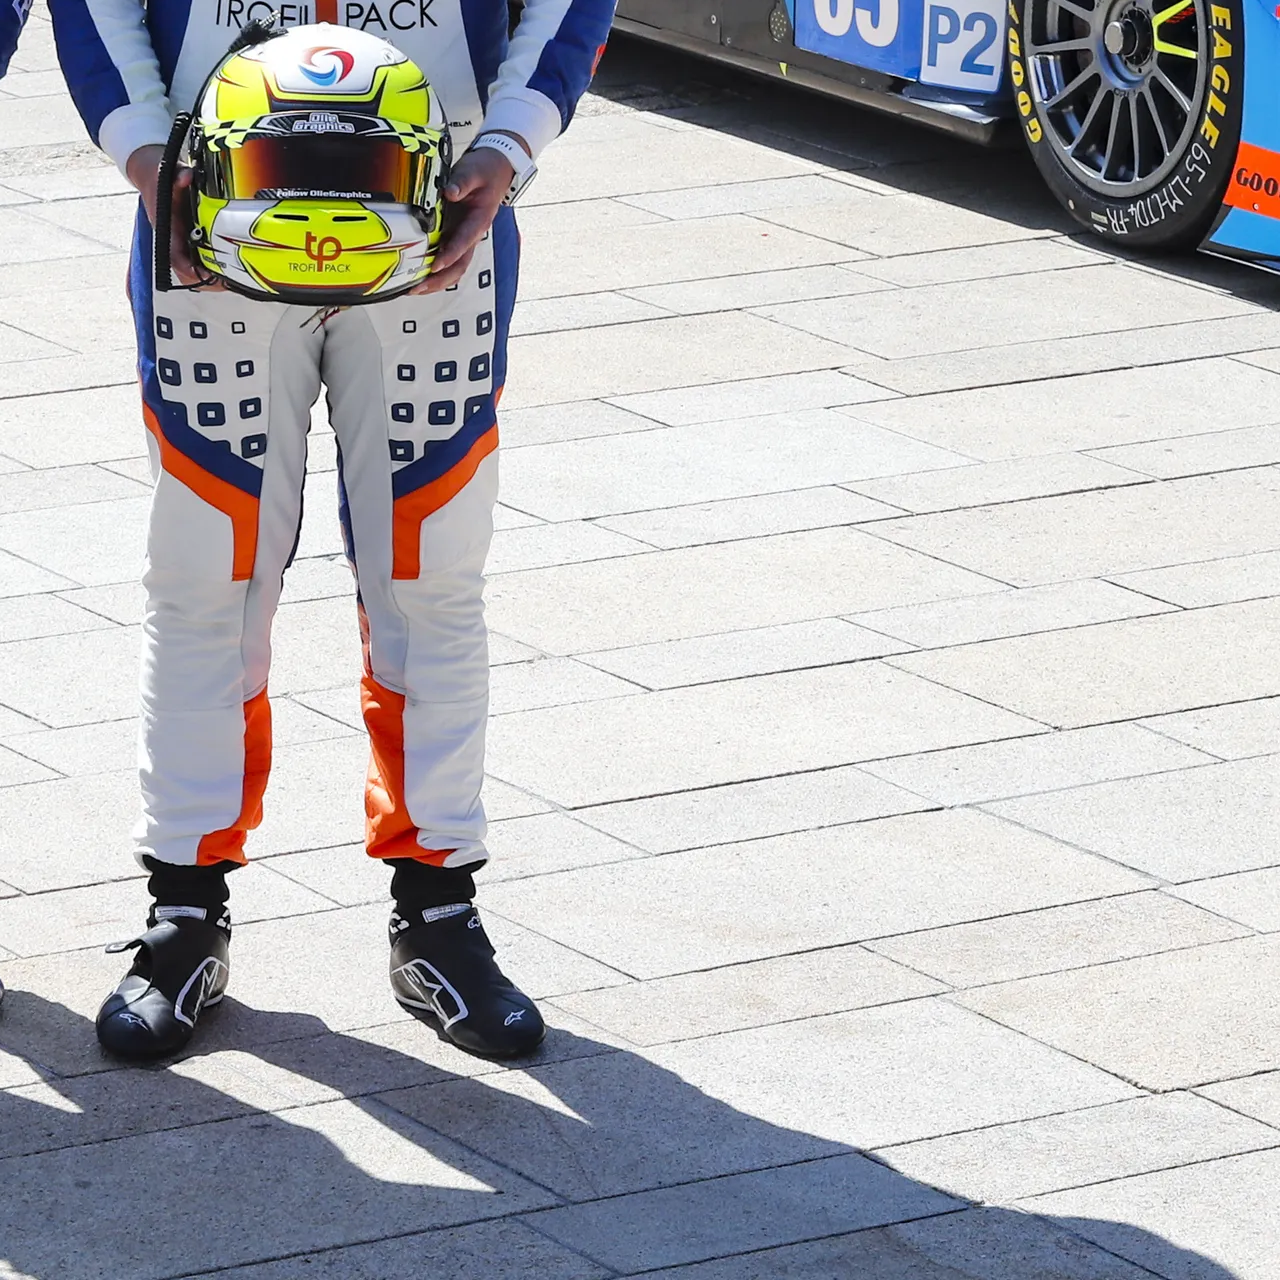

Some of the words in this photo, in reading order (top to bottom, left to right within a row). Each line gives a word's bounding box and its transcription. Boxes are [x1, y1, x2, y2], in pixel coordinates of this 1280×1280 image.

[926, 4, 1000, 76] P2
[1198, 3, 1233, 149] EAGLE
[293, 121, 354, 133] Graphics
[277, 190, 309, 198] Follow
[324, 263, 351, 273] PACK
